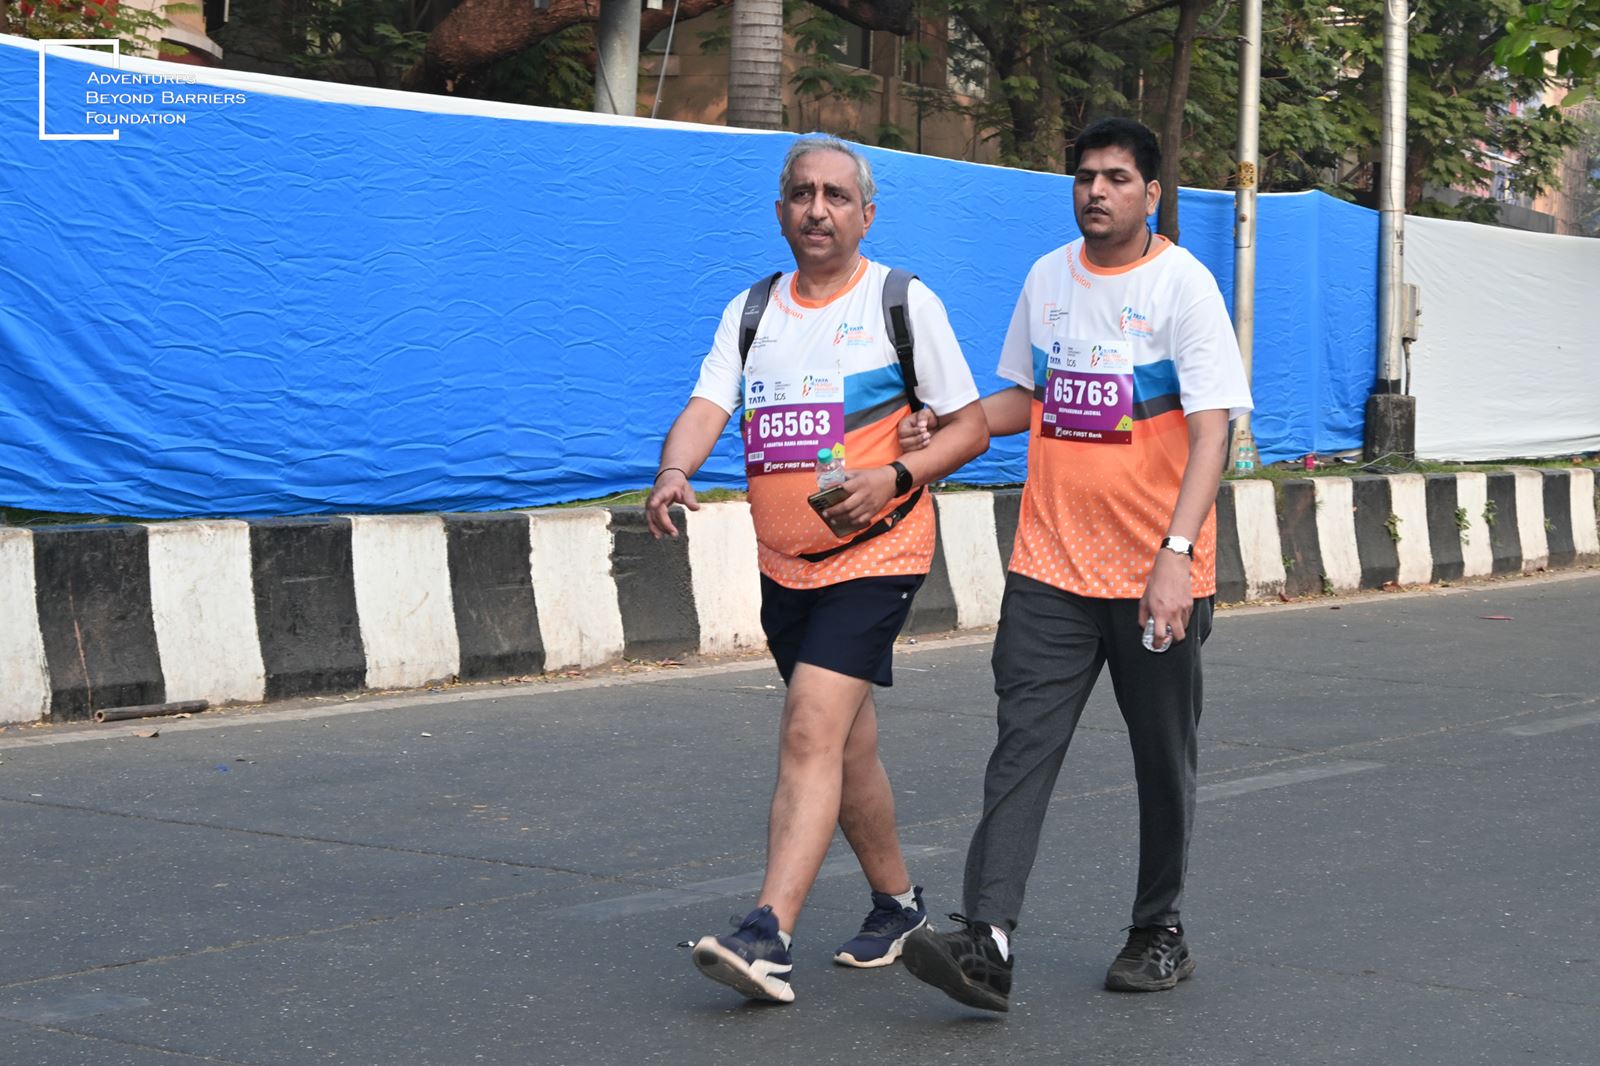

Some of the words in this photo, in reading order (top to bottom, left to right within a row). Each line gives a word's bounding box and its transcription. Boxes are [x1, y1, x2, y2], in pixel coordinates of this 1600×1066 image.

[748, 395, 766, 404] TATA
[1054, 377, 1119, 407] 65763
[759, 409, 831, 439] 65563
[801, 461, 815, 469] Bank
